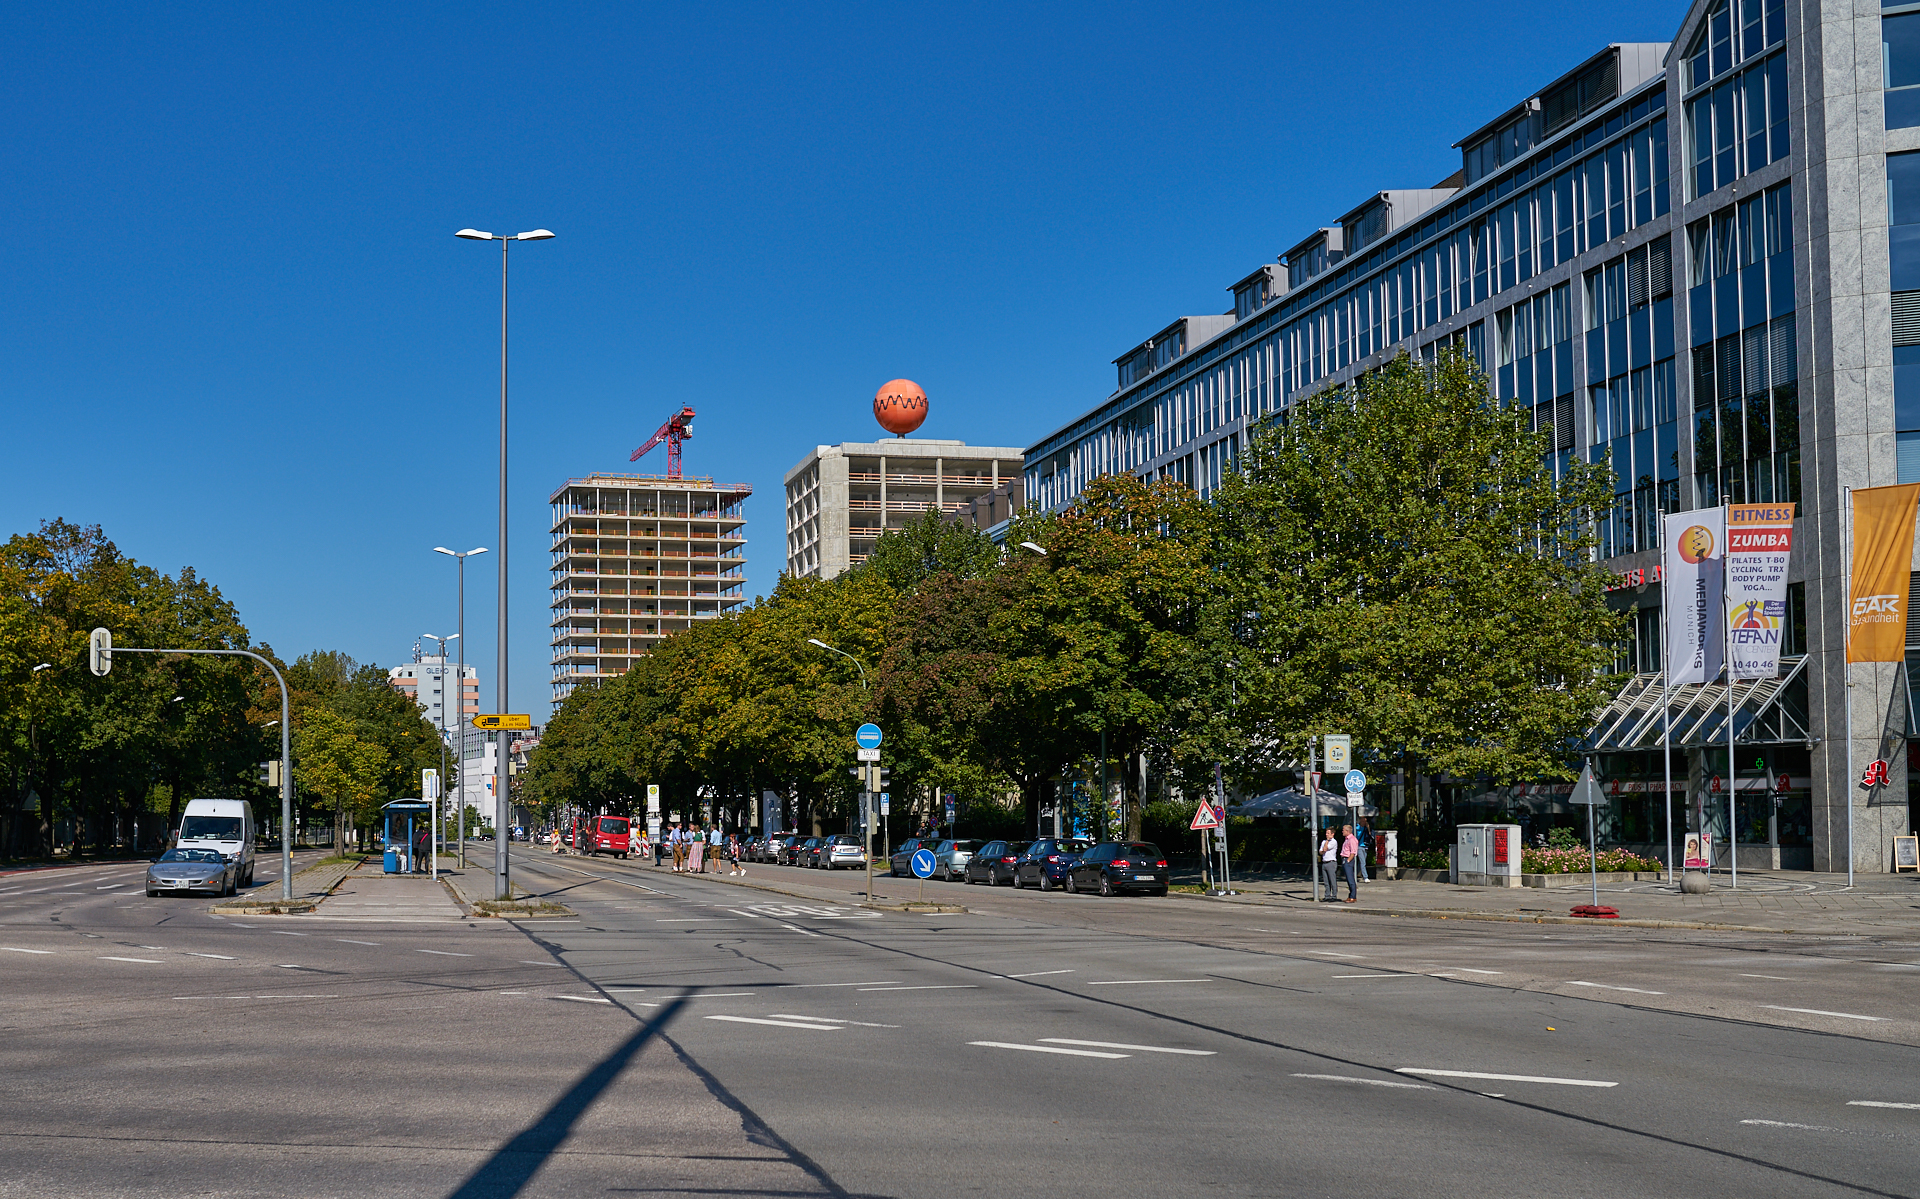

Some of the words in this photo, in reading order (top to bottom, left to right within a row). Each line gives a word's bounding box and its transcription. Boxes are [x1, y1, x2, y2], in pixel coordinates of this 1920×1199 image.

[1733, 509, 1790, 521] FITNESS
[1731, 534, 1788, 547] ZUMBA
[1687, 605, 1695, 645] MUNICH
[1693, 578, 1707, 669] MEDIAWORKS
[1731, 629, 1779, 644] TEFAN
[1745, 660, 1759, 669] 40
[1760, 660, 1774, 668] 46
[1649, 782, 1684, 791] PHARACY
